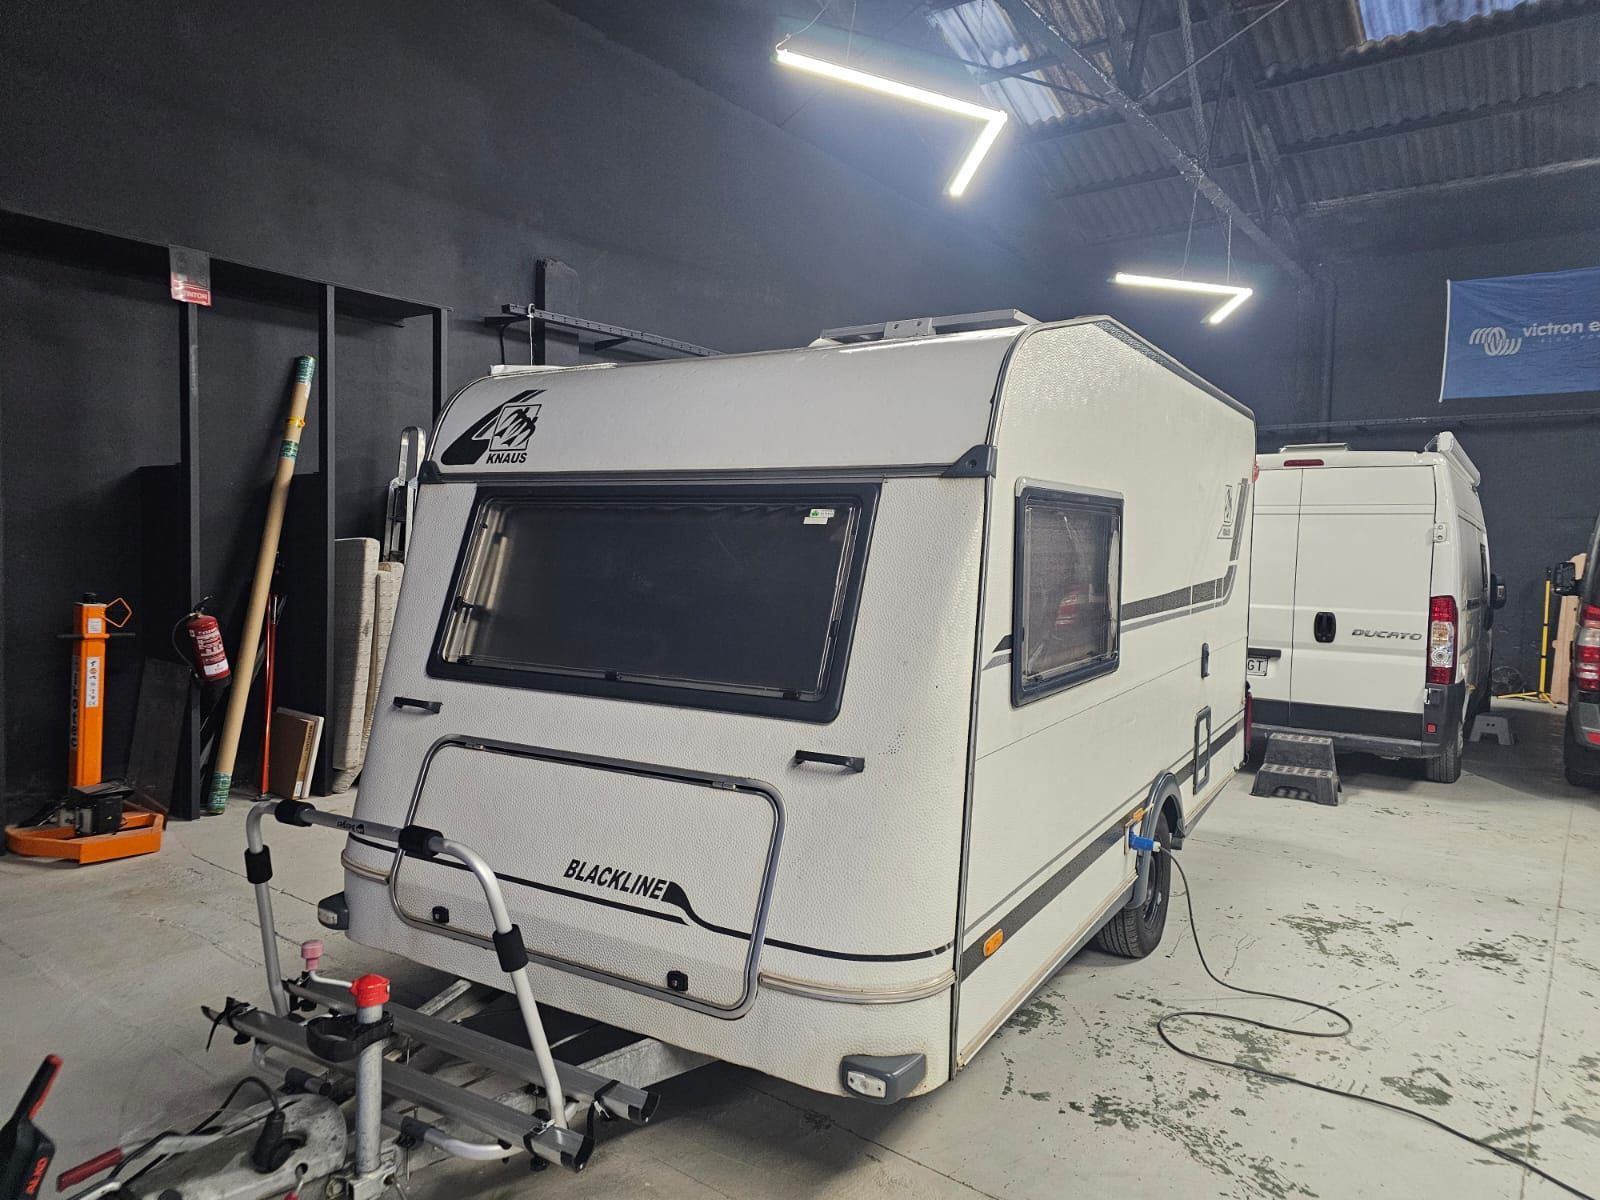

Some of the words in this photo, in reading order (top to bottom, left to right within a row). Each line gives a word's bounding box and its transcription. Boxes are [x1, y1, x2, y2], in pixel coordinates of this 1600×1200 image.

[1523, 322, 1583, 337] victron
[486, 452, 528, 464] KNAUS
[1351, 628, 1422, 641] DUCATO
[563, 858, 668, 900] BLACKLINE
